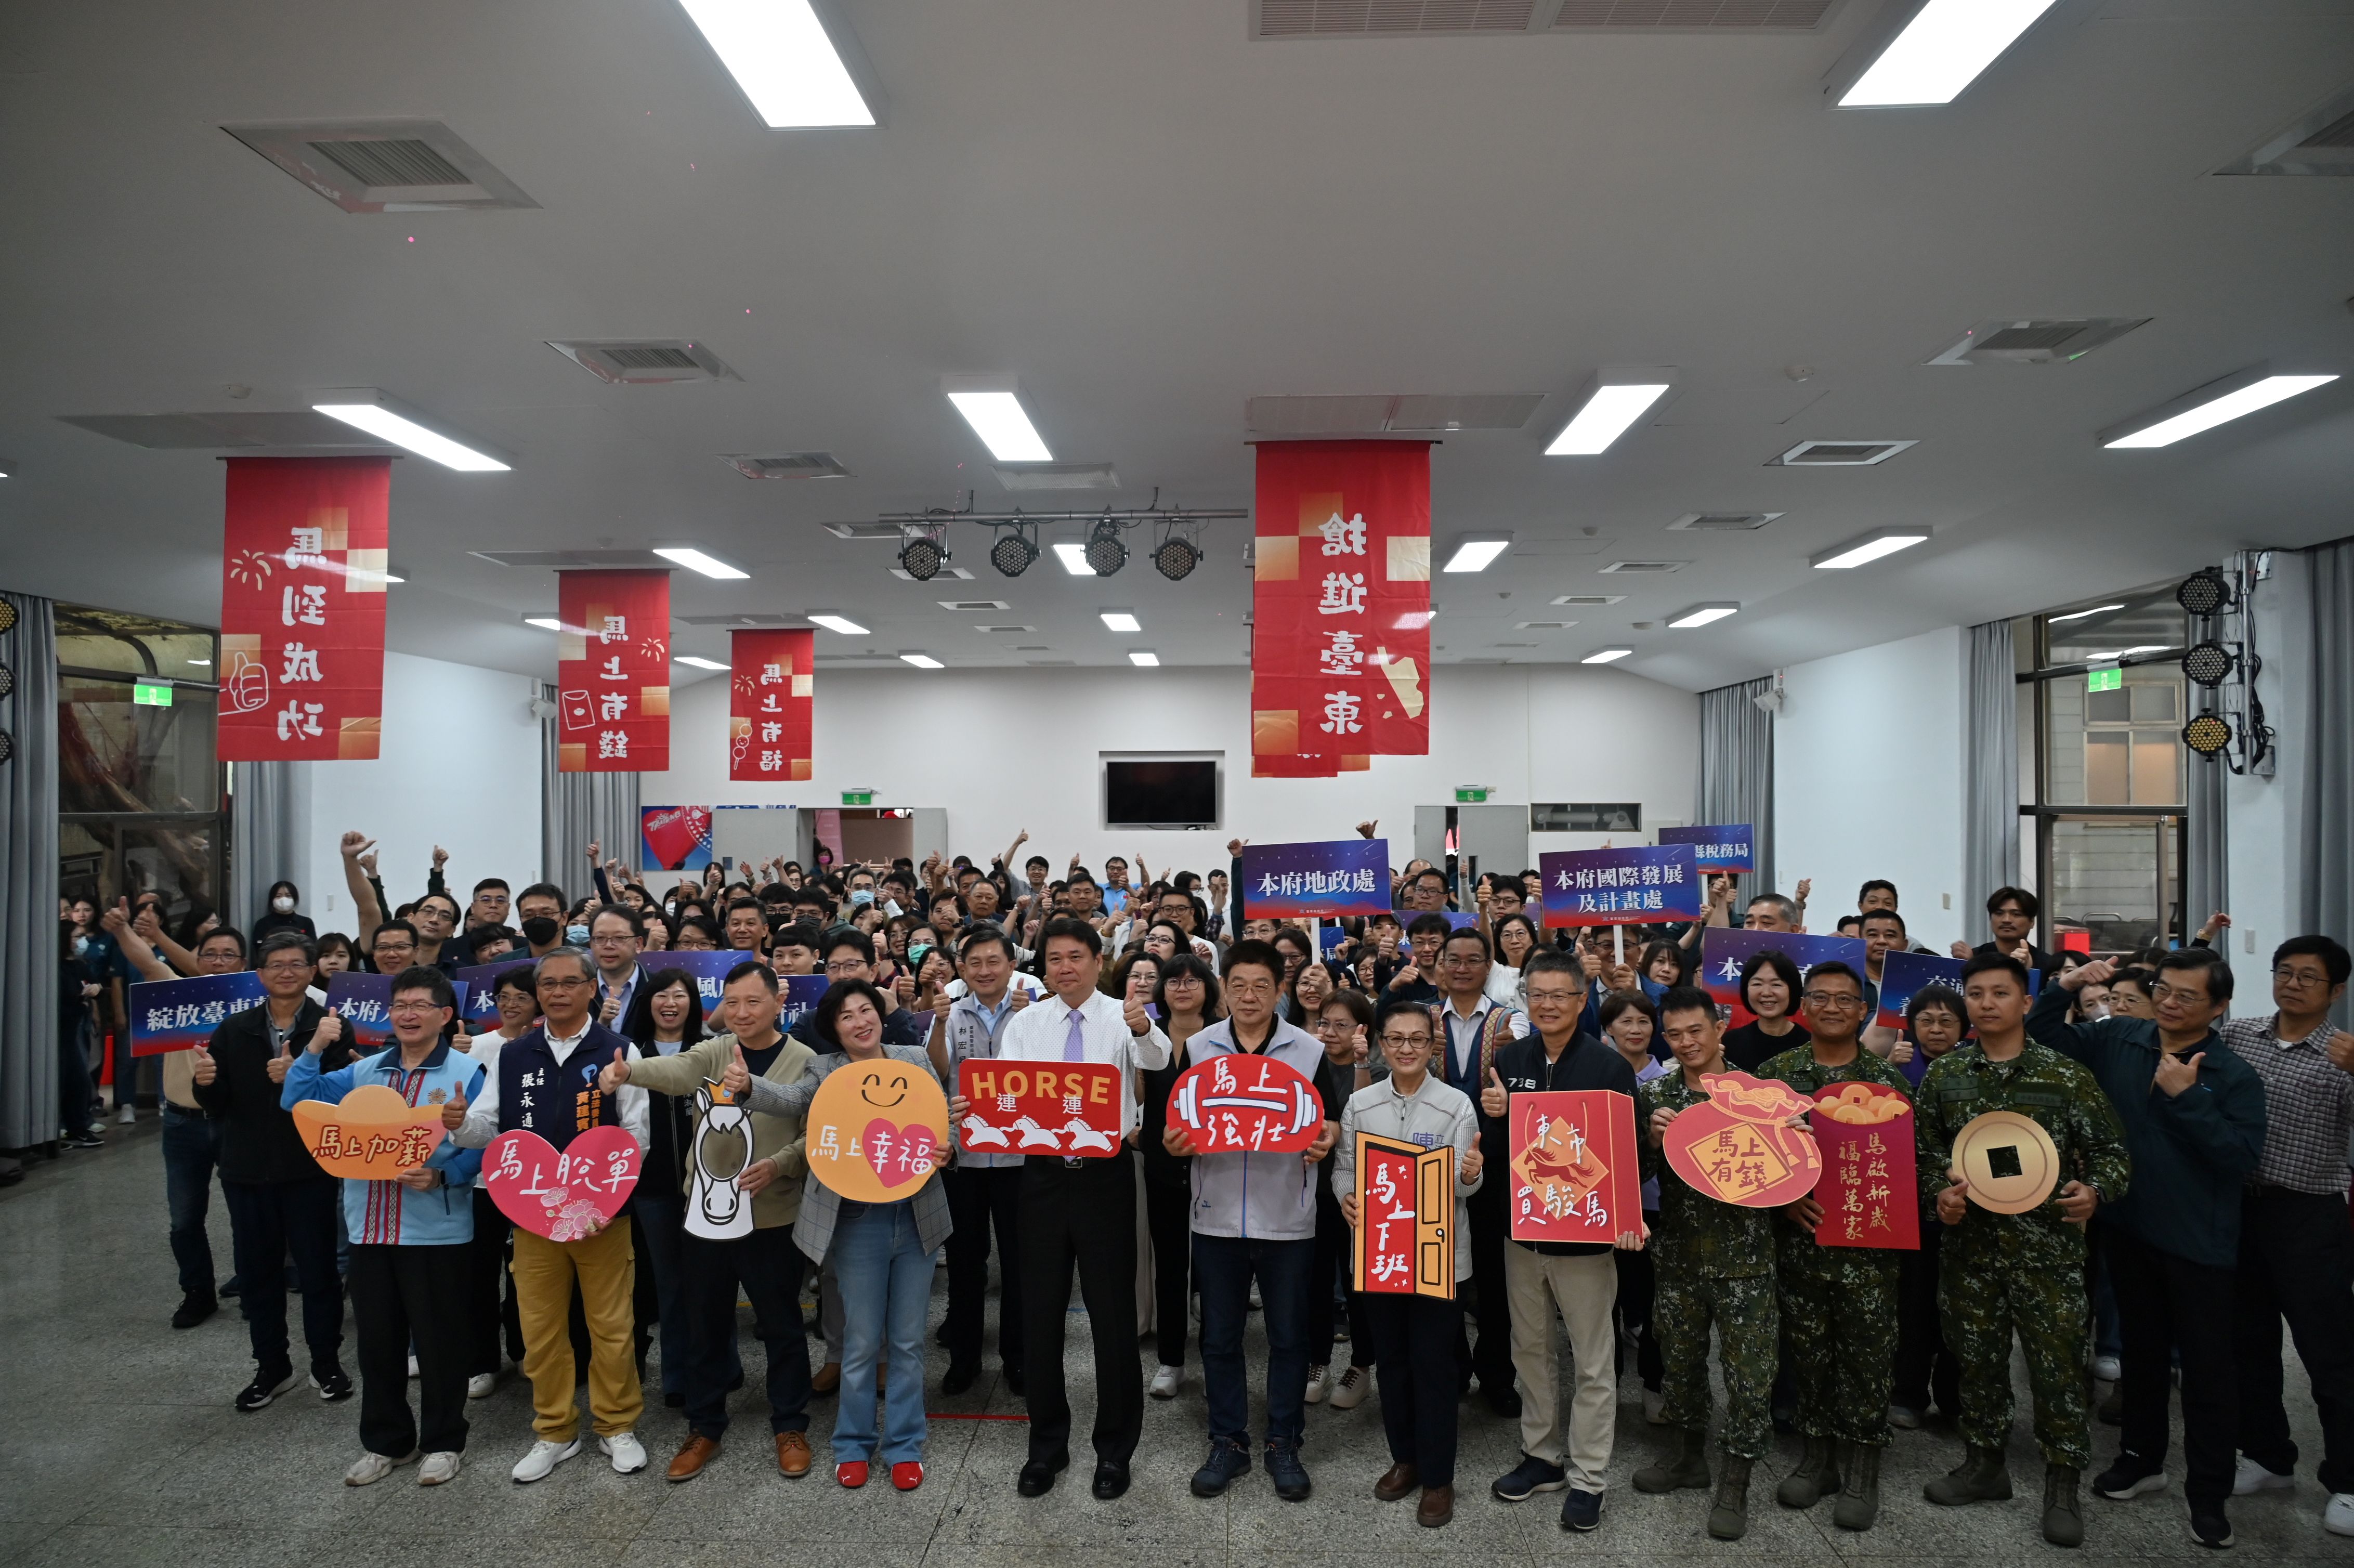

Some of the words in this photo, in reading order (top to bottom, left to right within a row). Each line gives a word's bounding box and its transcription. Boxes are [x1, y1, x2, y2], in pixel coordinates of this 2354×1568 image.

[1257, 868, 1376, 897] 本府地政處
[1554, 864, 1684, 891] 本府國際發展
[1577, 890, 1664, 913] 及計畫處
[536, 1067, 545, 1086] 主任
[971, 1070, 1111, 1104] HORSE
[1212, 1057, 1288, 1095] 馬上
[520, 1073, 535, 1128] 張永通
[997, 1092, 1017, 1112] 連
[1062, 1094, 1083, 1115] 連
[312, 1124, 433, 1167] 馬上加薪
[812, 1125, 933, 1175] 馬上幸福
[1207, 1112, 1287, 1151] 強壯
[1533, 1113, 1585, 1165] 東市
[1712, 1130, 1765, 1158] 馬上
[488, 1139, 639, 1195] 馬上脫單
[1708, 1160, 1768, 1190] 有錢
[1517, 1183, 1607, 1227] 買駿馬
[1839, 1141, 1864, 1241] 福臨萬家
[1365, 1162, 1416, 1282] 馬上下班
